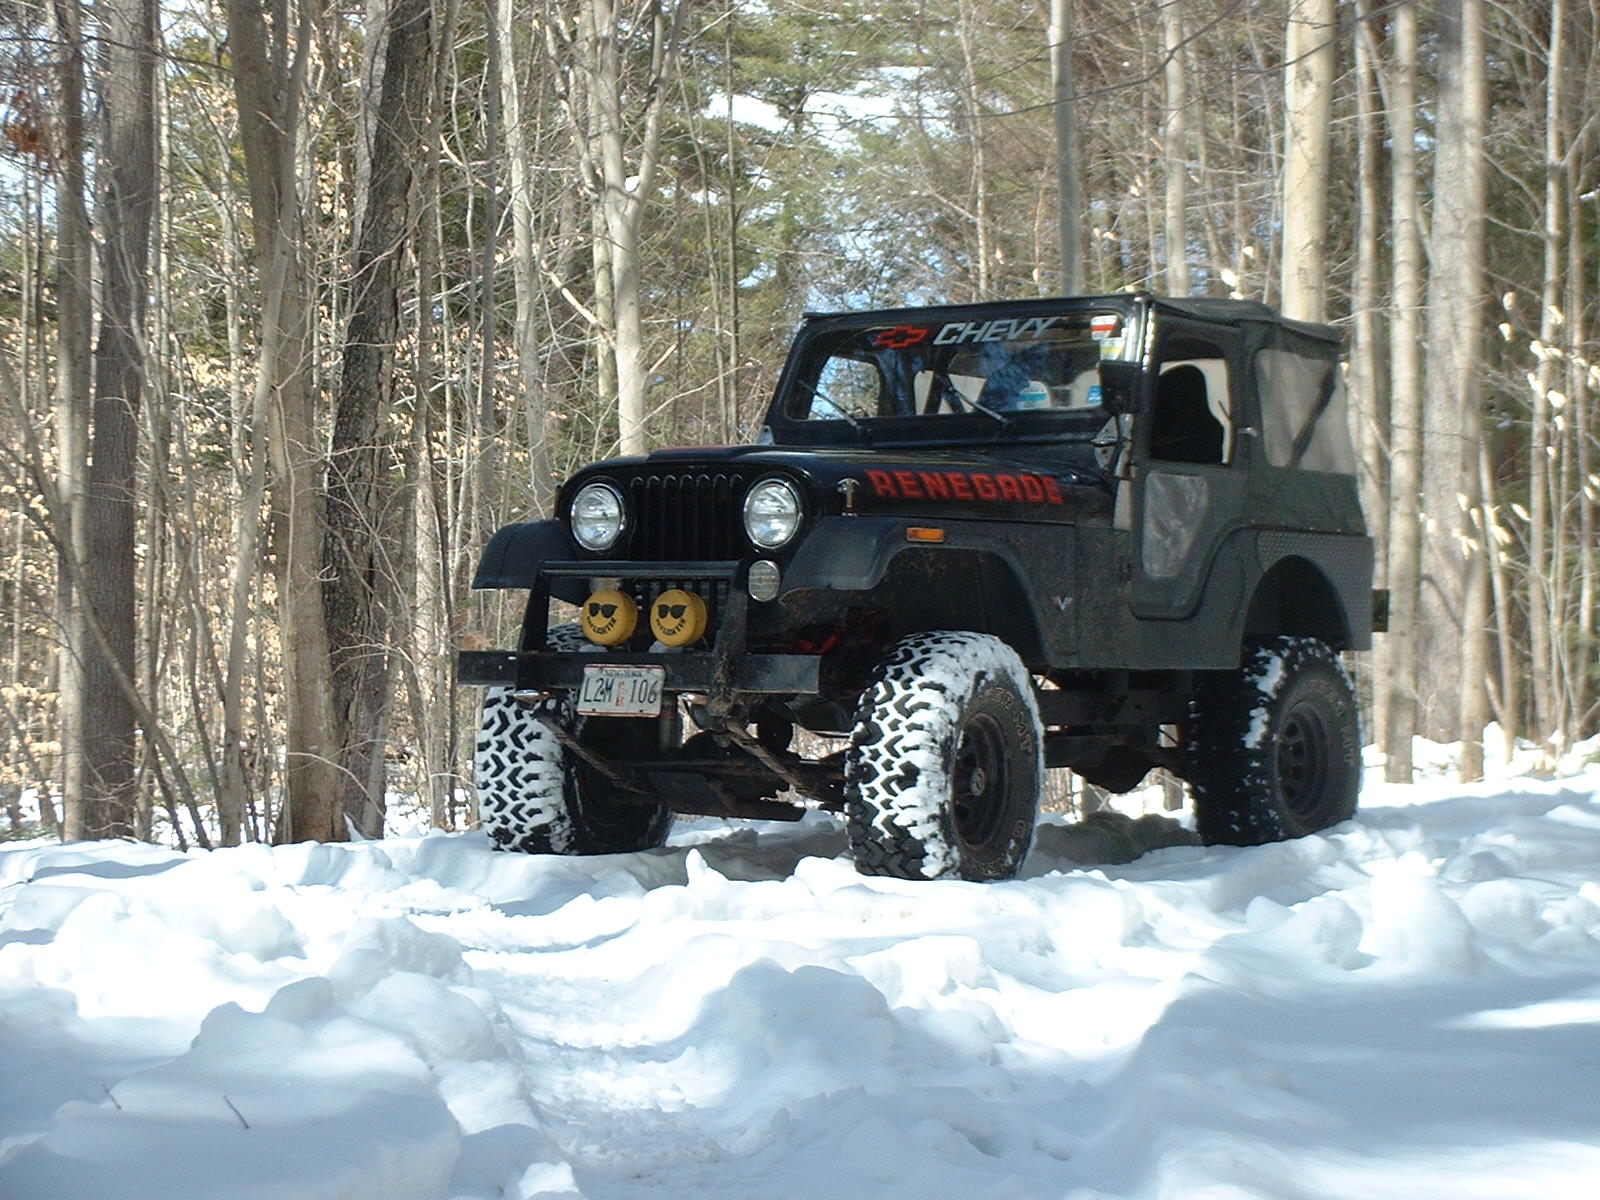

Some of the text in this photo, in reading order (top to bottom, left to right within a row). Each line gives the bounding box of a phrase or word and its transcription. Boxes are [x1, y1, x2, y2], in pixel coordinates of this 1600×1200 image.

[932, 316, 1059, 346] CHEVY
[865, 468, 1064, 505] RENEGADE
[630, 679, 658, 704] 106
